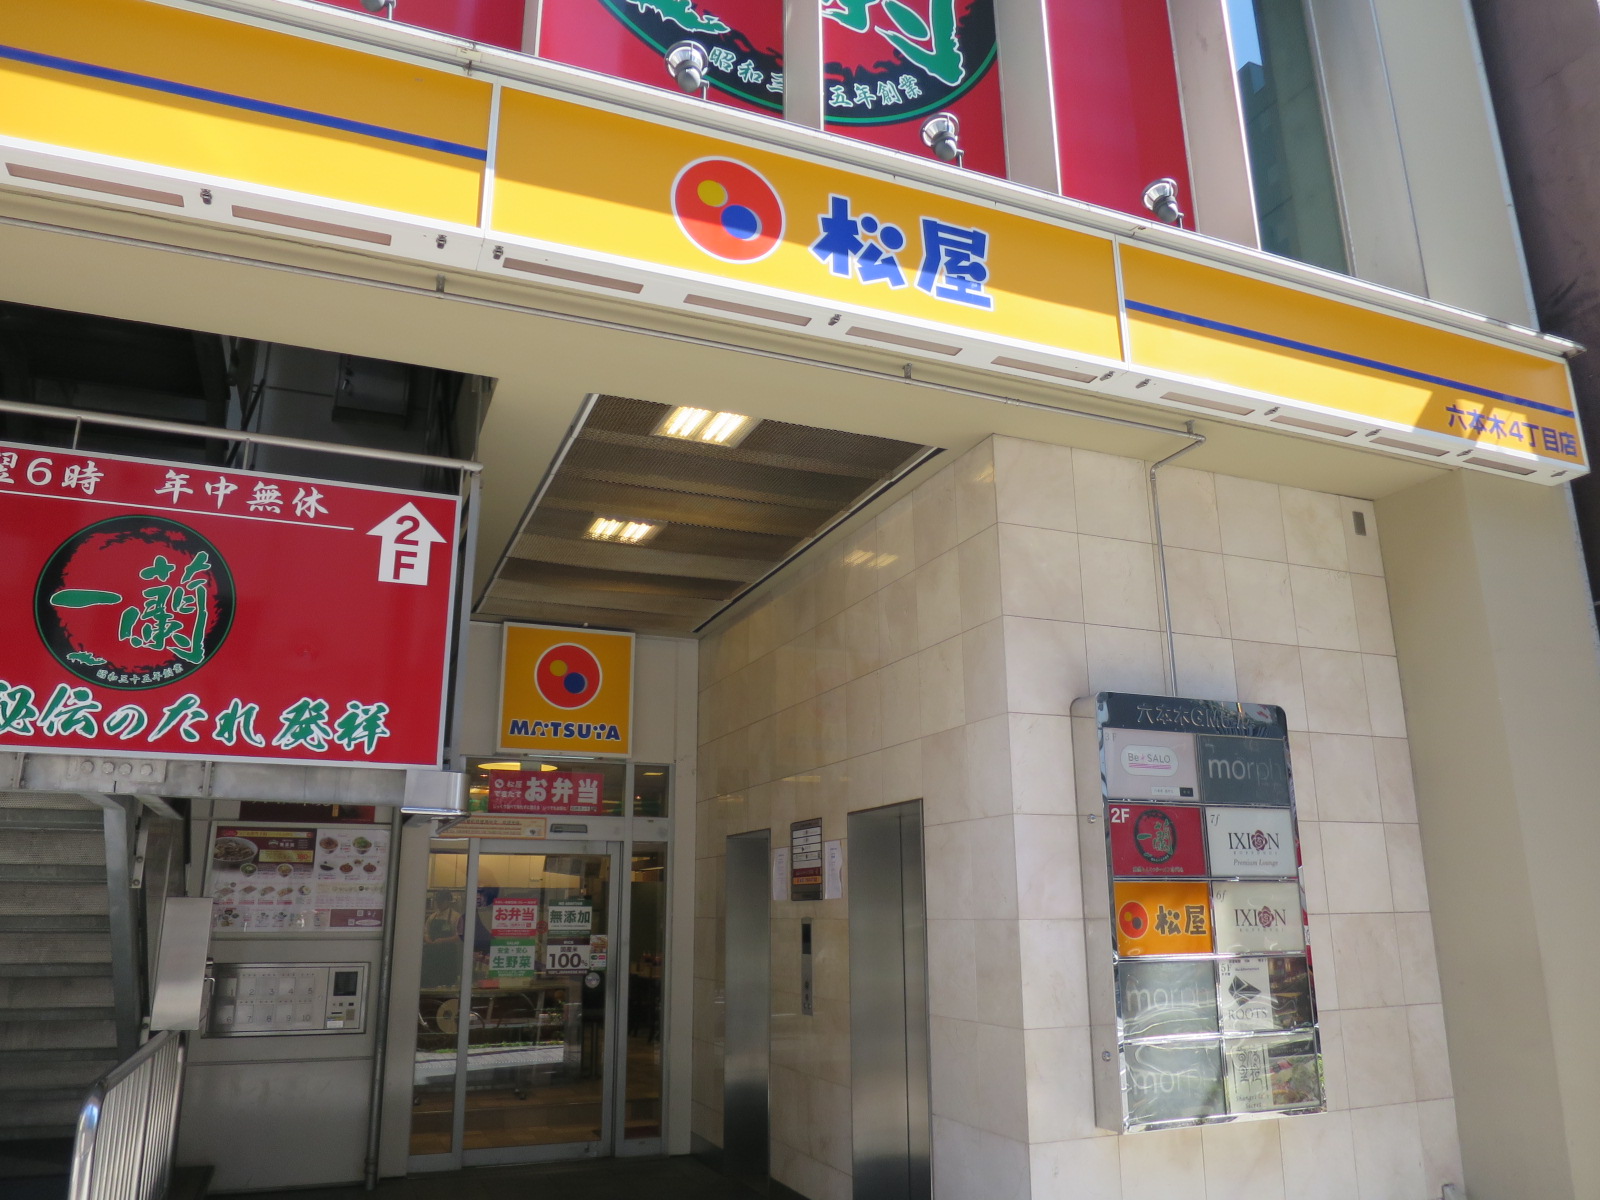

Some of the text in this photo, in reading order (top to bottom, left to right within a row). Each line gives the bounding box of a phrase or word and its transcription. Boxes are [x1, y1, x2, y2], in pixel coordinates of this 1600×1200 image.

[708, 47, 923, 109] 昭和三五年創業
[809, 194, 993, 311] 松屋
[1445, 404, 1577, 457] 六本木4丁目店
[154, 470, 329, 518] 年中無休
[393, 515, 421, 580] 2F
[50, 551, 211, 665] 一蘭
[96, 663, 184, 685] 昭和三十五年創業
[0, 682, 390, 754] 秘伝のたれ発祥
[509, 719, 621, 741] MATSUYA
[1208, 757, 1284, 787] morph
[524, 777, 598, 804] お弁当
[1111, 808, 1130, 823] 2F
[1210, 814, 1220, 827] 7f
[1137, 819, 1174, 855] 一蘭
[1228, 831, 1280, 850] IXION
[1233, 858, 1279, 868] Premium Lounge
[1216, 889, 1227, 901] 6f
[495, 907, 534, 921] お弁当
[550, 910, 590, 923] 無添加
[1155, 905, 1207, 936] 松屋
[1234, 907, 1287, 928] IXION
[492, 955, 531, 968] 生野菜
[549, 953, 588, 968] 100%
[302, 1014, 310, 1022] 10
[1228, 1006, 1268, 1021] ROOTS
